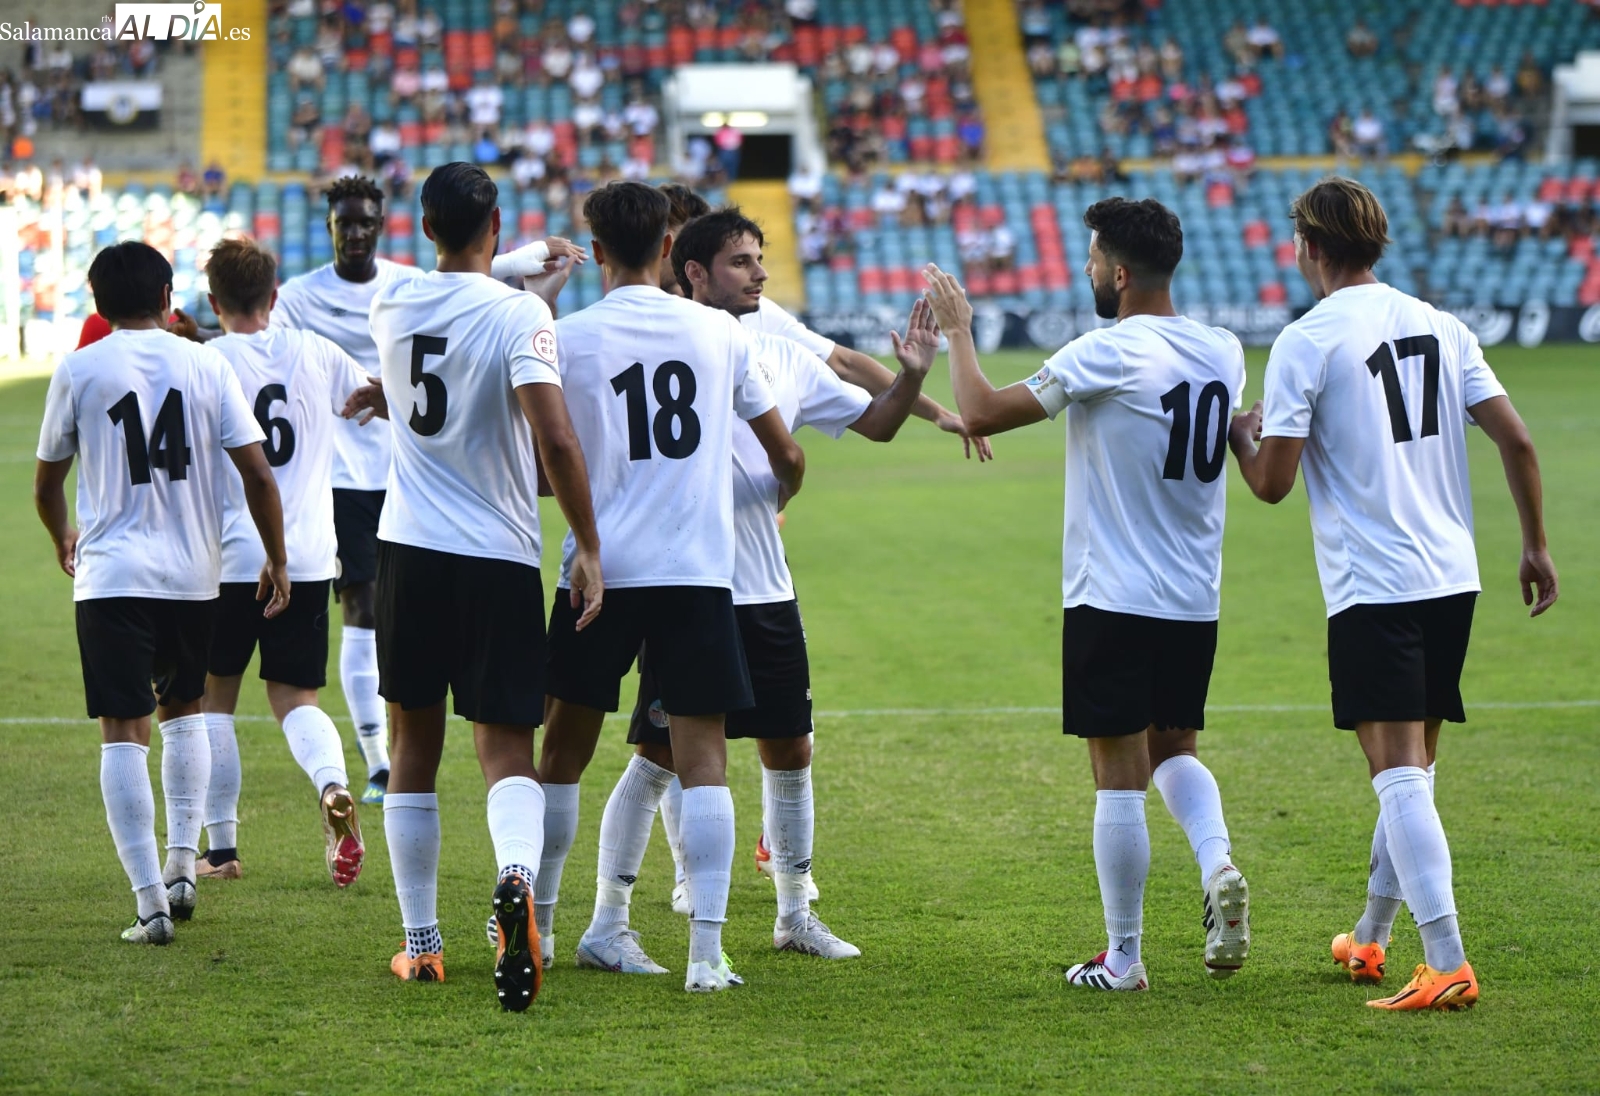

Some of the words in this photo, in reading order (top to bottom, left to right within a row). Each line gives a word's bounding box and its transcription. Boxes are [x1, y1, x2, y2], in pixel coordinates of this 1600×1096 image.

[254, 383, 295, 468] 6
[409, 334, 447, 436] 5
[610, 361, 700, 460] 18
[1160, 380, 1230, 483] 10
[1366, 335, 1439, 443] 17
[107, 388, 191, 485] 14
